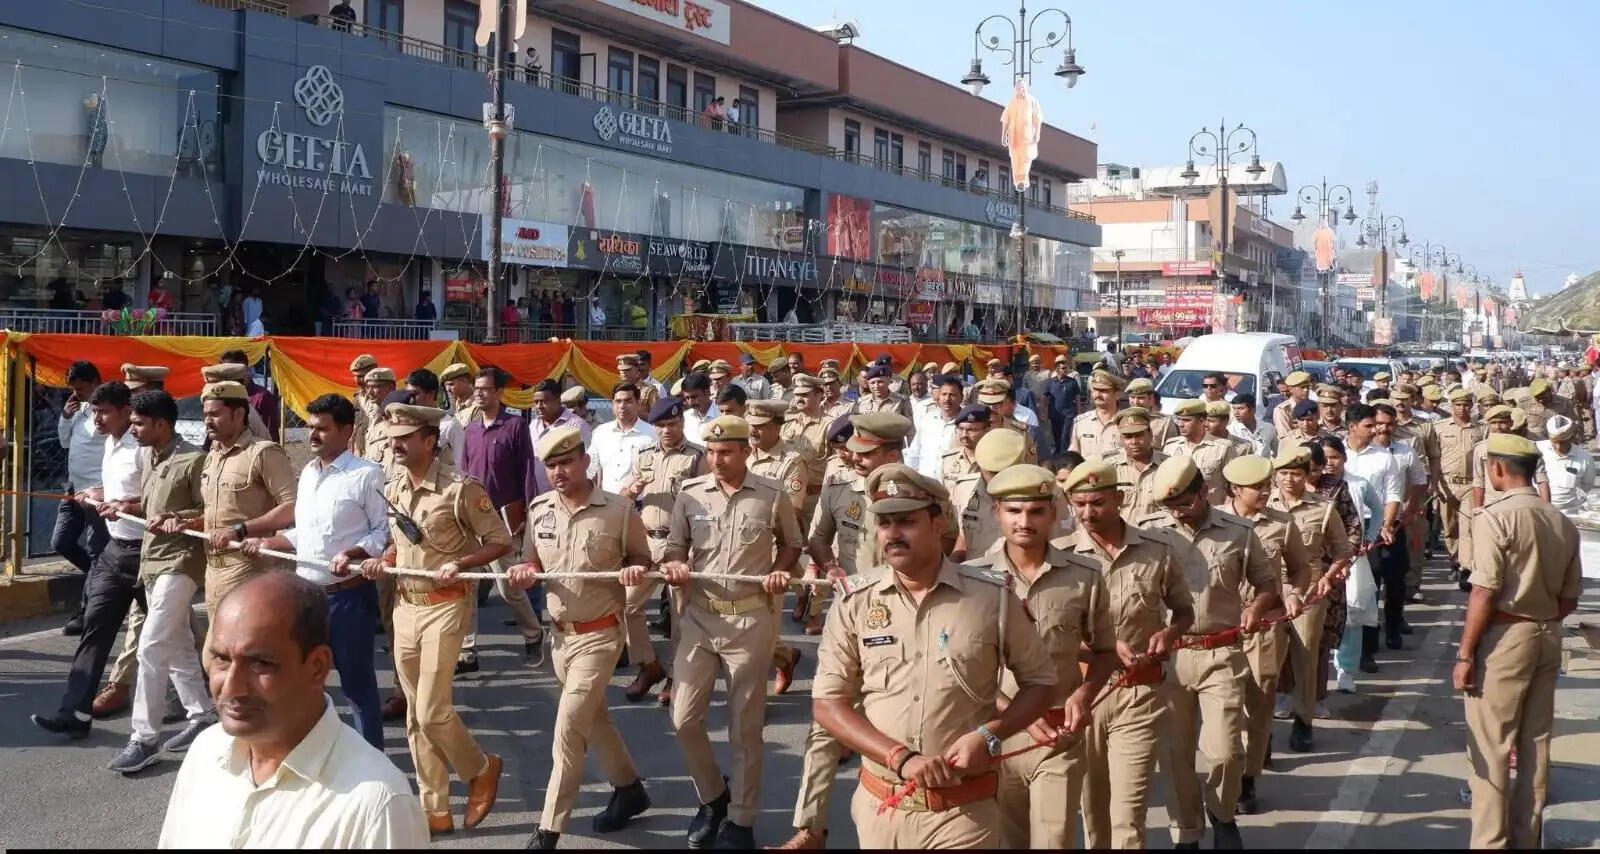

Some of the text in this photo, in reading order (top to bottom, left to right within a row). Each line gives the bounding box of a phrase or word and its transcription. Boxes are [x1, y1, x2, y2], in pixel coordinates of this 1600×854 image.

[619, 112, 672, 143] GEETA
[257, 129, 375, 179] GEETA
[257, 169, 373, 196] WHOLESALE MART
[599, 234, 640, 255] राधिका
[650, 241, 708, 260] SEAWORLD
[746, 255, 787, 279] TITAN
